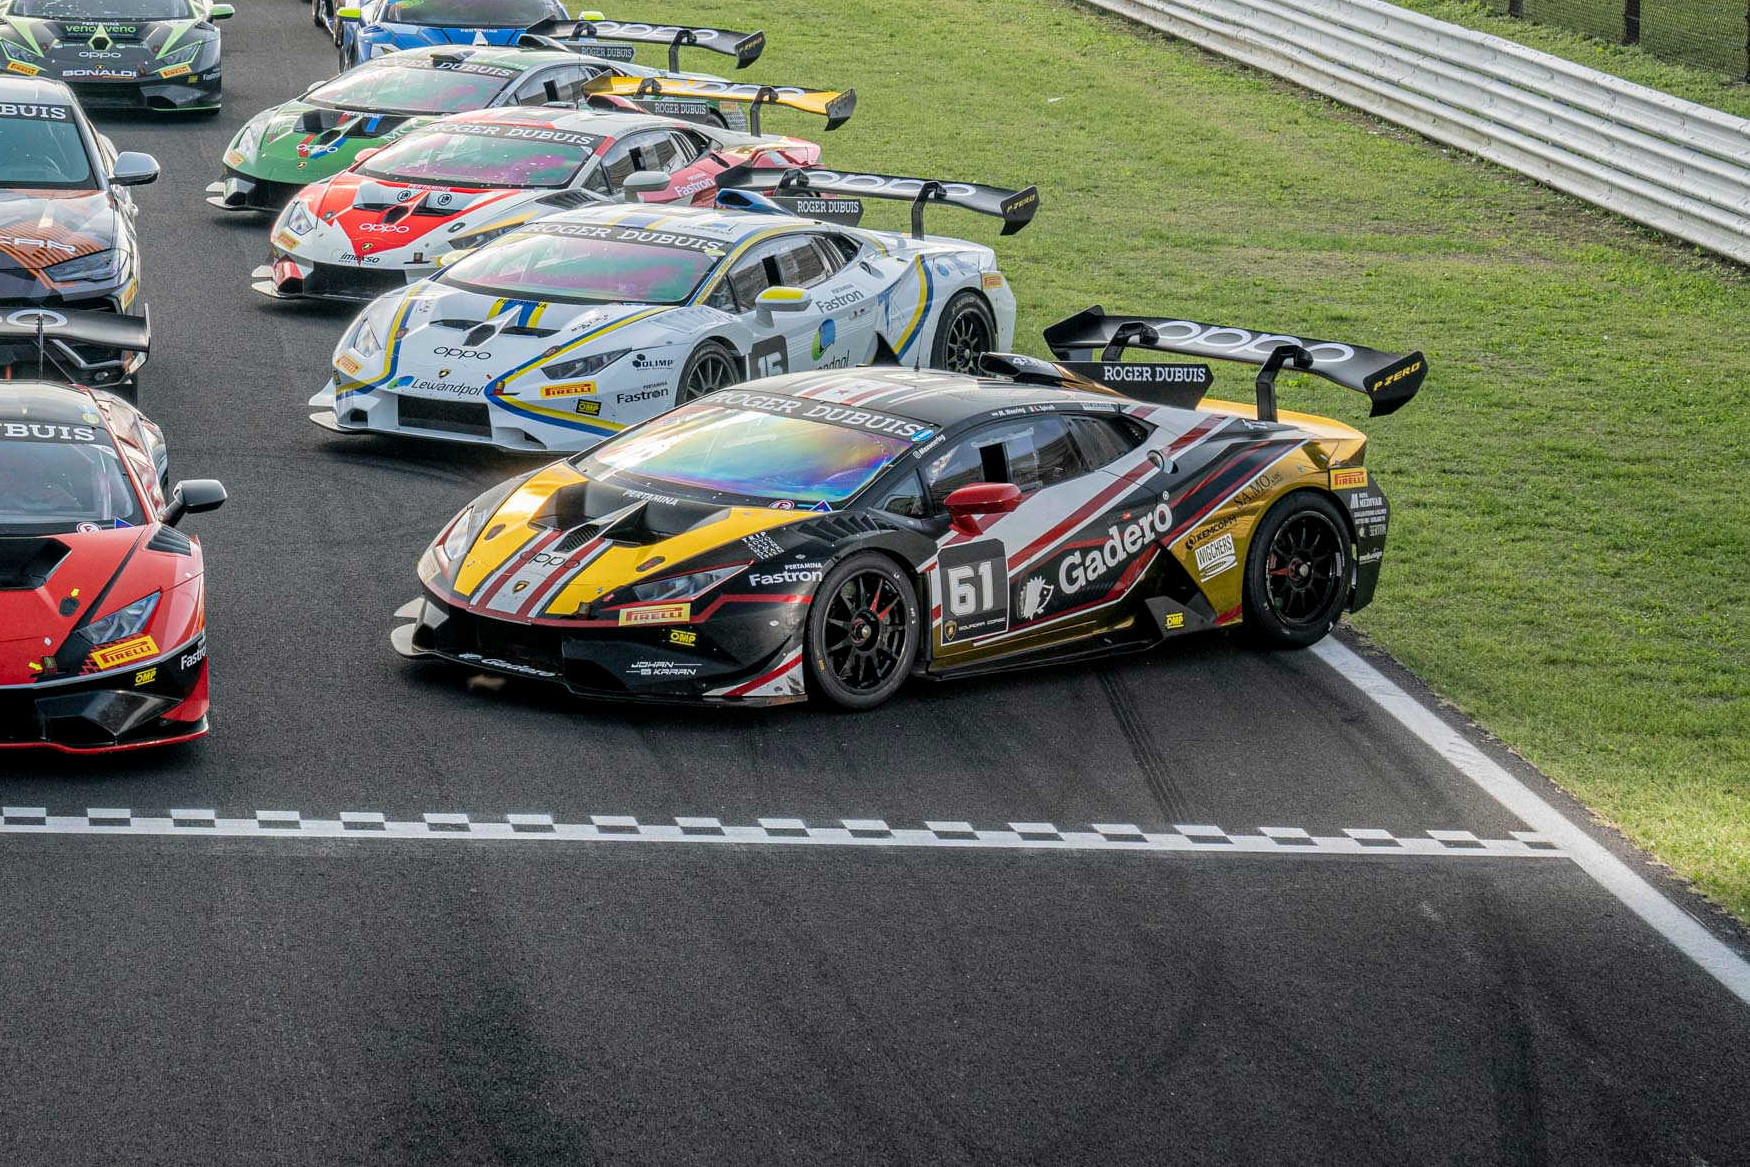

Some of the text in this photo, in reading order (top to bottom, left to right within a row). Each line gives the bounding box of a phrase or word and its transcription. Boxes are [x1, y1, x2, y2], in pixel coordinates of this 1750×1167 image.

[65, 25, 137, 33] veno veno
[78, 51, 122, 59] oppo
[581, 46, 633, 59] ROGER DUBUIS
[62, 69, 137, 78] BONALDI
[437, 60, 517, 77] DUBUIS
[655, 103, 707, 115] ROGER DUBUIS
[432, 121, 500, 136] ROGER
[507, 126, 595, 146] DUBUIS
[675, 177, 715, 196] Fastron
[797, 200, 860, 214] ROGER DUBUIS
[359, 222, 409, 234] oppo
[524, 221, 726, 253] ROGER DUBUIS
[815, 288, 865, 313] Fastron
[1155, 320, 1355, 363] oppo
[434, 345, 492, 360] oppo
[642, 359, 674, 368] OLIMP
[1103, 366, 1206, 382] ROGER DUBUIS
[1373, 360, 1422, 392] P ZERO
[410, 377, 485, 397] Lewandpol
[545, 384, 592, 396] PIRELLI
[616, 387, 669, 405] Fastron
[578, 401, 600, 413] OMP
[707, 391, 926, 439] ROGER DUBUIS
[1334, 471, 1365, 486] PIRELLI
[623, 489, 680, 505] PERTAMINA
[1058, 502, 1173, 595] Gadero
[1195, 534, 1233, 567] WIGCHERS
[519, 550, 582, 570] oppo
[784, 561, 823, 570] PERTAMINA
[749, 569, 823, 588] Fastron
[948, 561, 994, 617] 61
[626, 608, 683, 622] PIRELLI
[1166, 616, 1184, 627] OMP
[670, 632, 696, 644] OMP
[95, 641, 156, 666] PIRELLI
[135, 670, 156, 683] OMP
